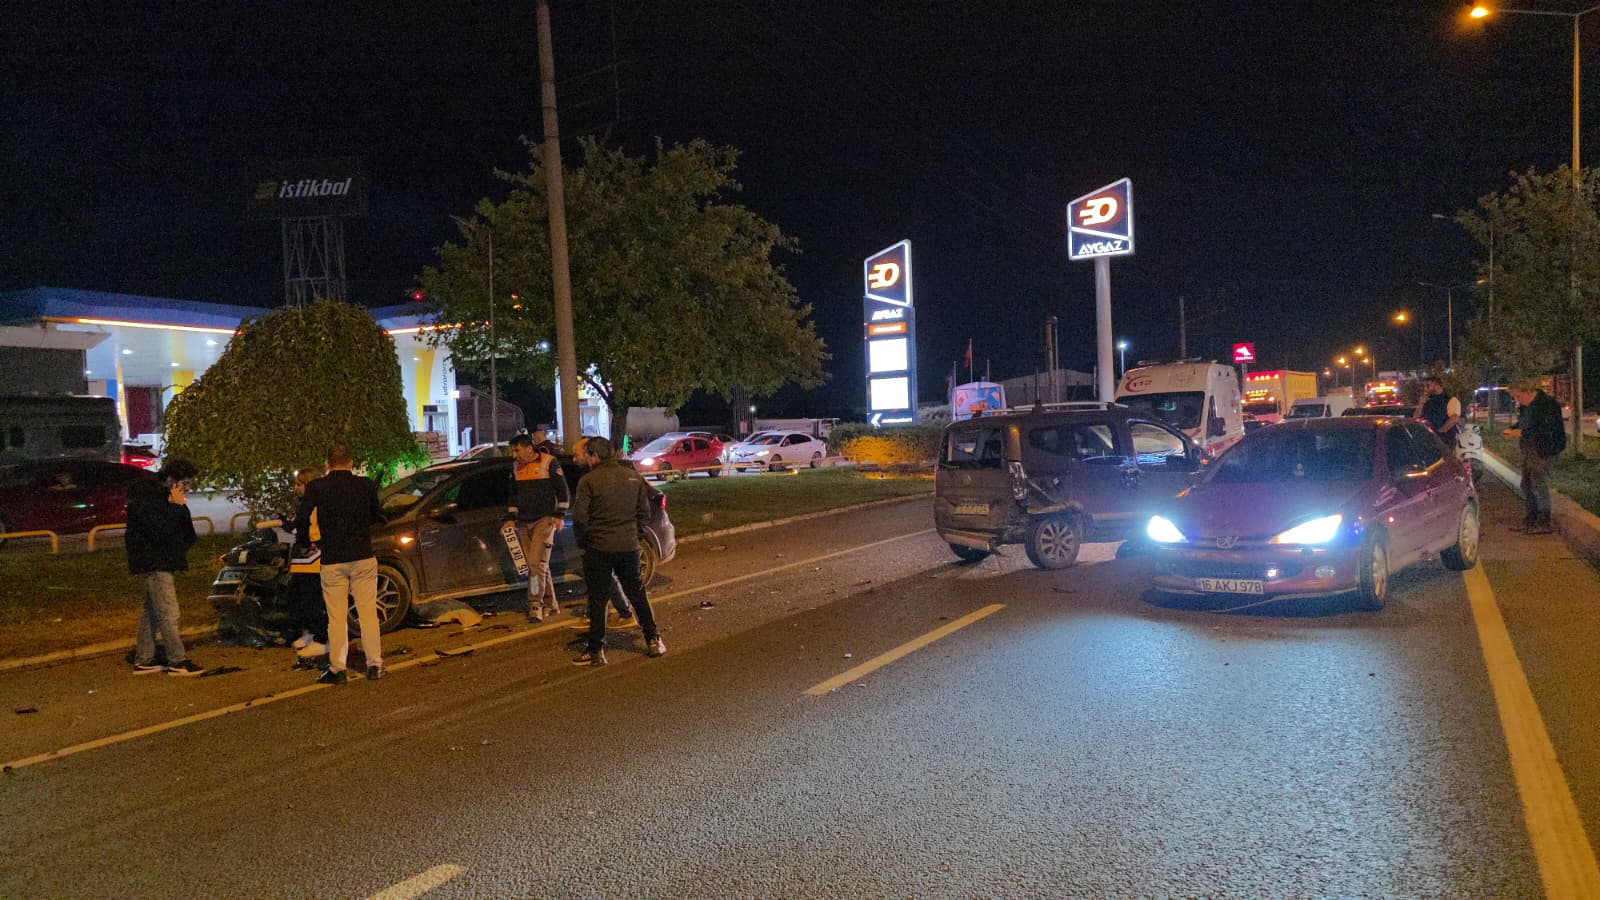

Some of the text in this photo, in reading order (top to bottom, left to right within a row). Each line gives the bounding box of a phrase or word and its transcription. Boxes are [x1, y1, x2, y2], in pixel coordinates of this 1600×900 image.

[279, 177, 352, 198] istikbal
[1079, 241, 1122, 255] AYGAZ
[1133, 379, 1152, 388] 112
[1215, 581, 1238, 592] AKJ
[1240, 582, 1262, 593] 978
